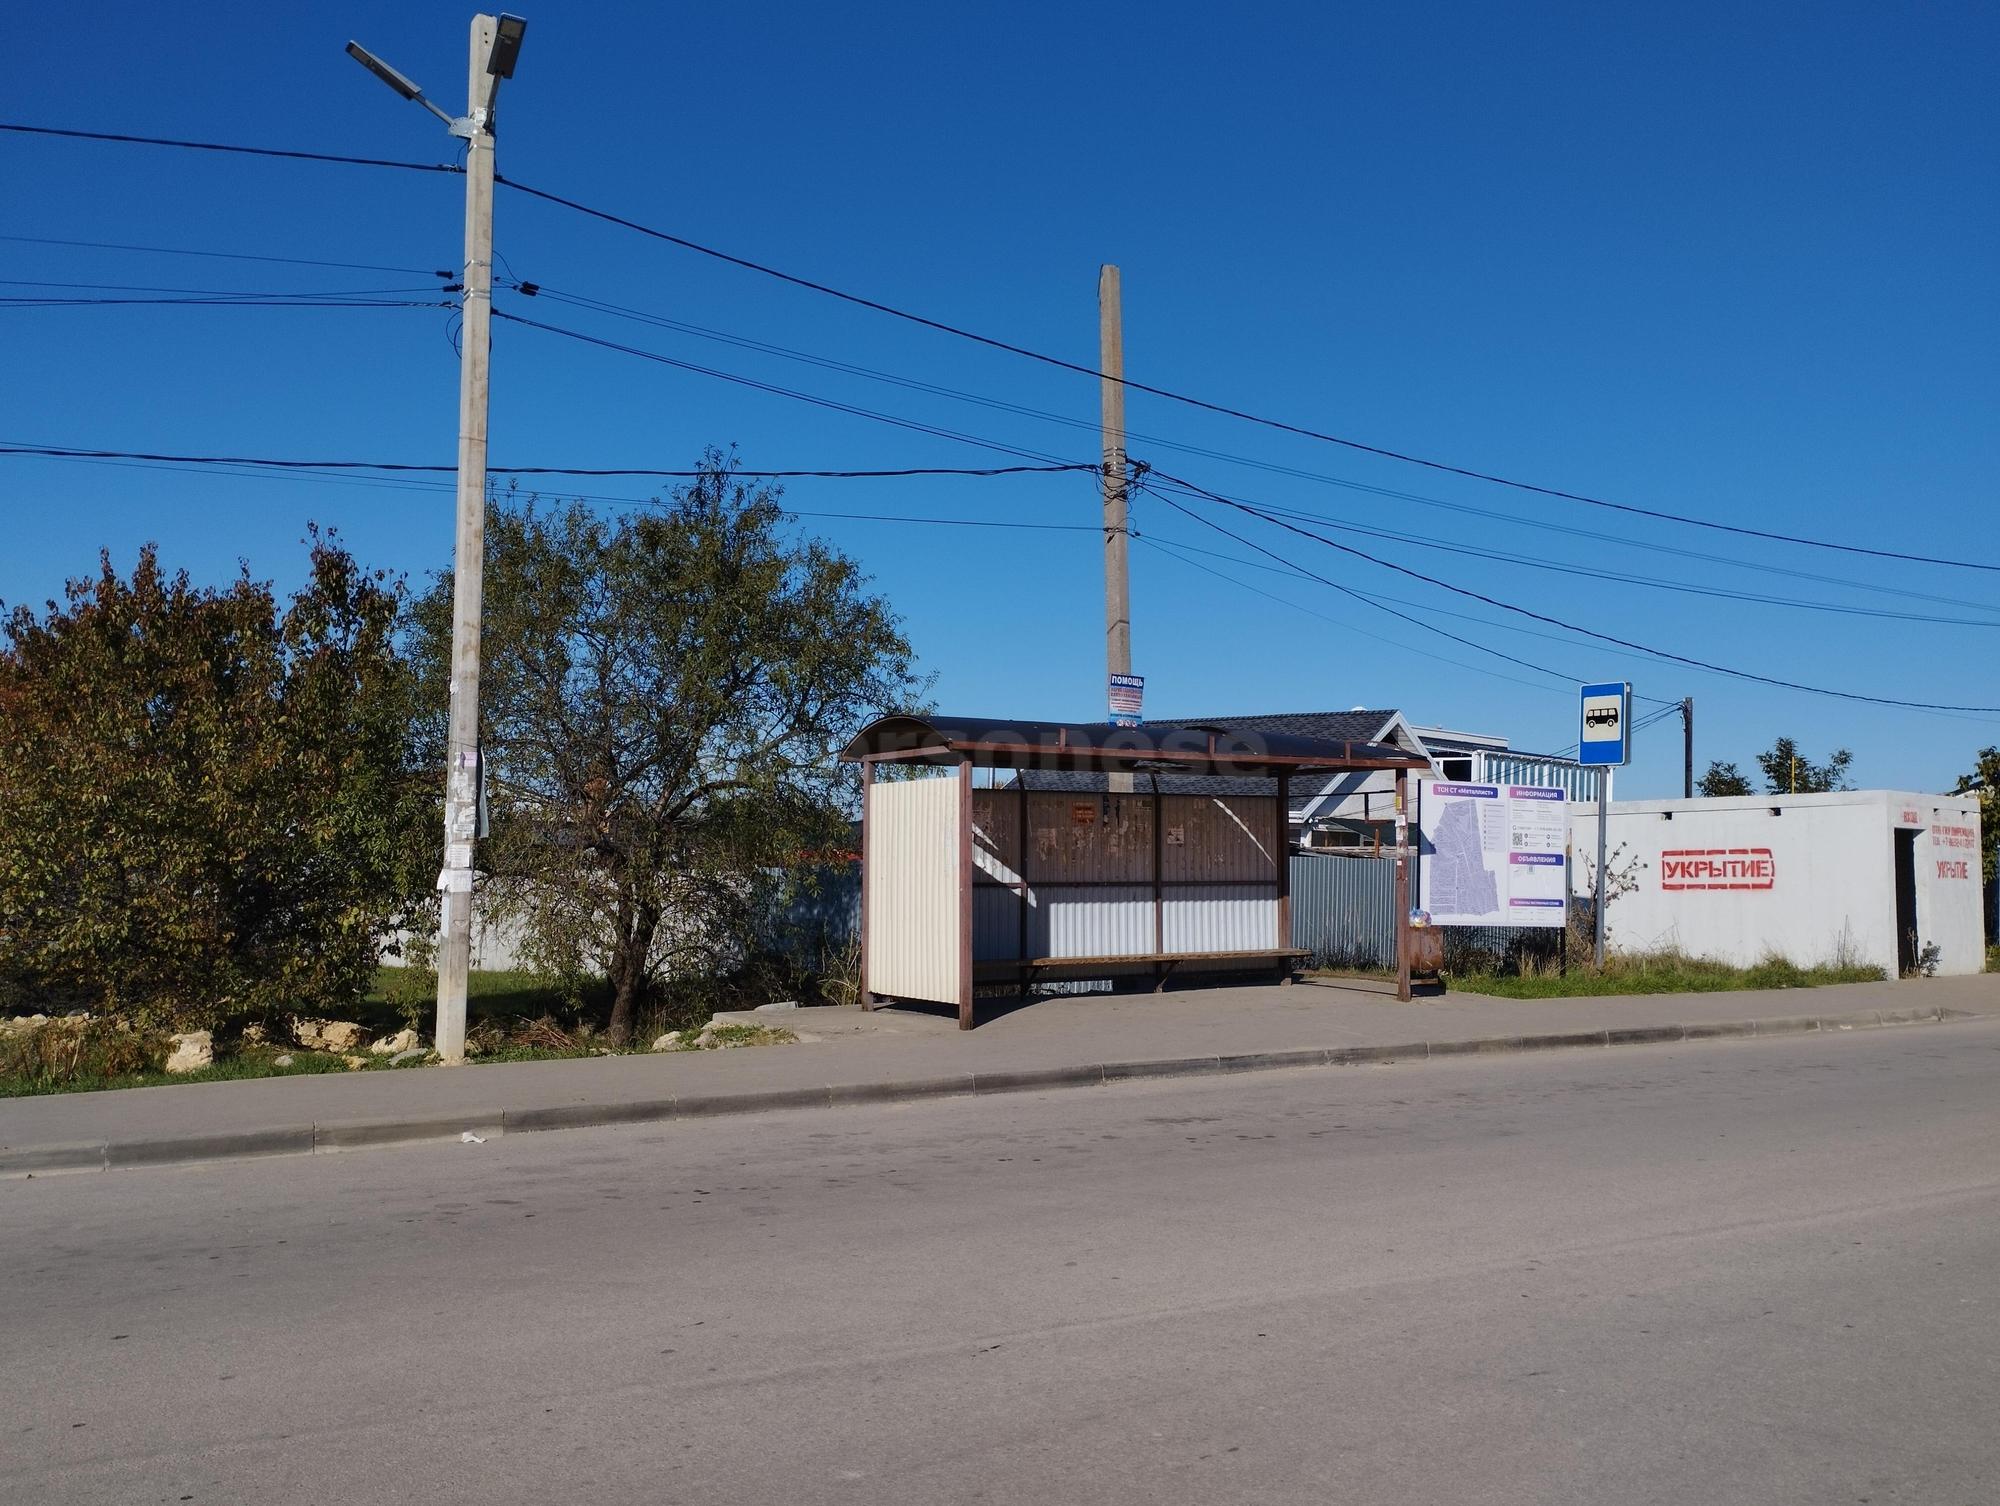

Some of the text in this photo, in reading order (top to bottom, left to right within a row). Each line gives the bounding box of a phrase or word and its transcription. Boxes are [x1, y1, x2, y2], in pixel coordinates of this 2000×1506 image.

[1111, 675, 1144, 687] ПОМОЩЬ
[1515, 790, 1558, 799] ИНФОРМАЦИЯ
[1517, 854, 1557, 863] ОБЪЯВЛЕНИЯ
[1665, 860, 1770, 879] УКРЫТИЕ
[1936, 860, 1968, 880] УКРЫТИЕ
